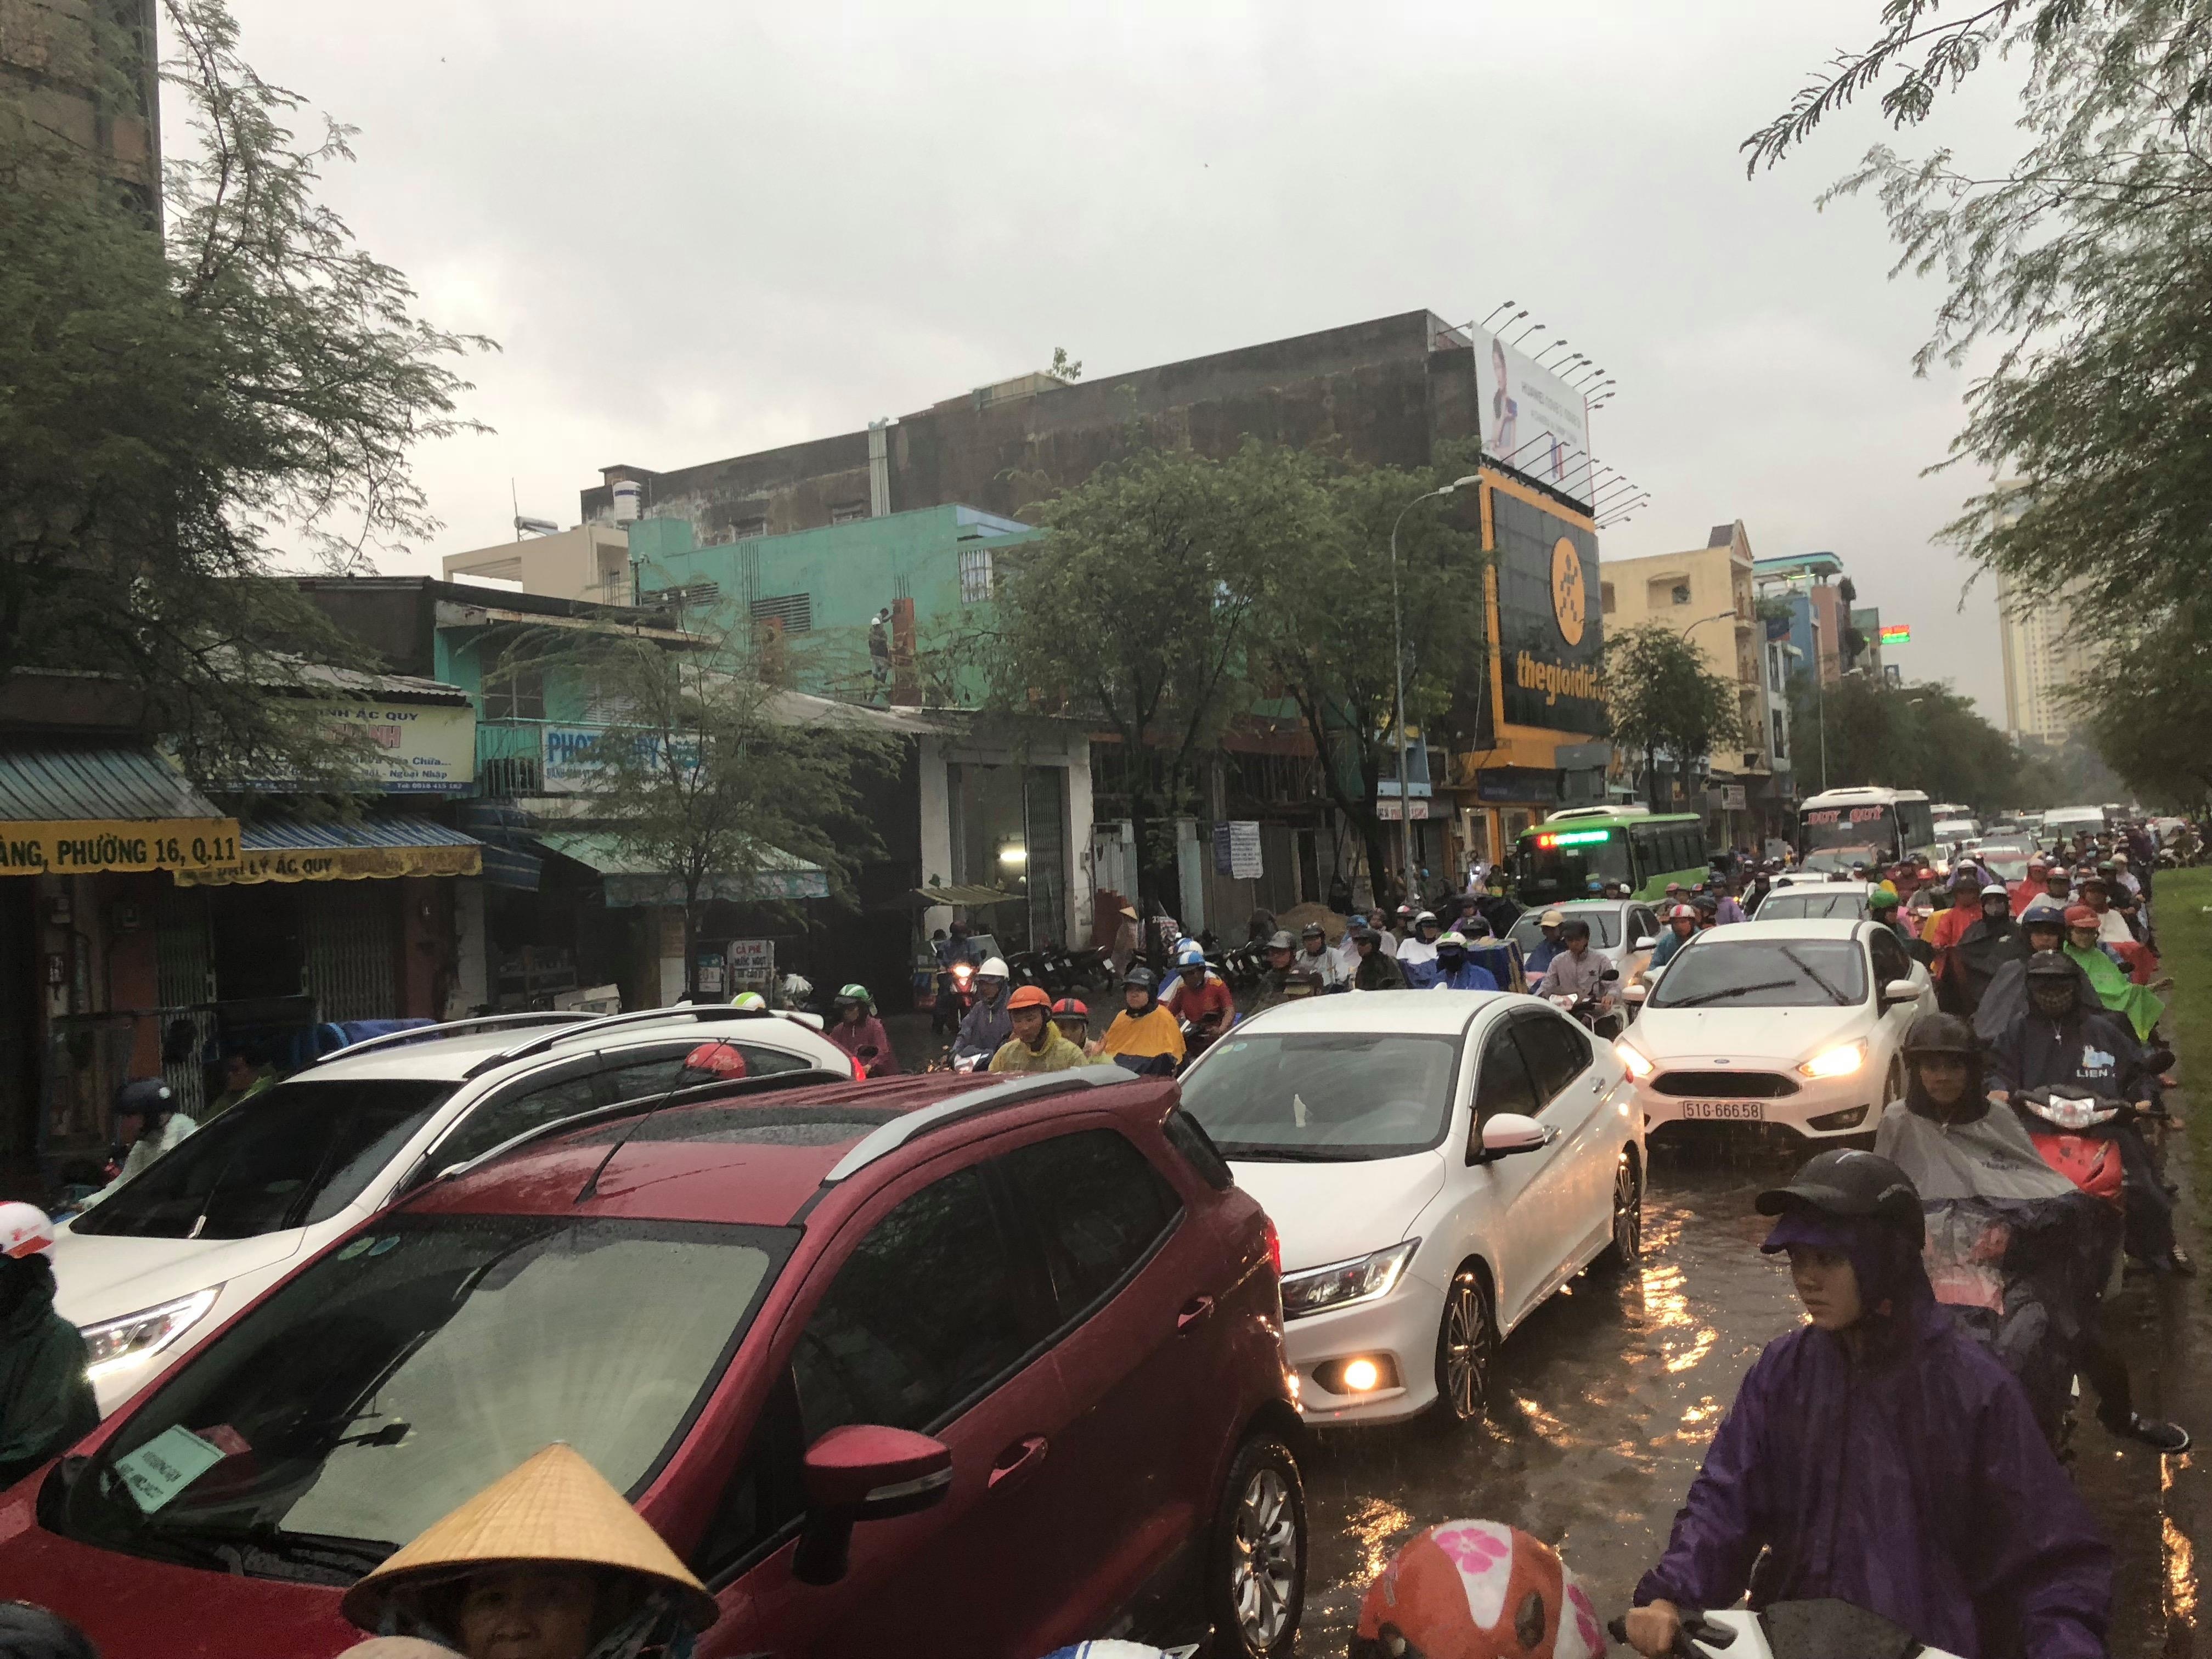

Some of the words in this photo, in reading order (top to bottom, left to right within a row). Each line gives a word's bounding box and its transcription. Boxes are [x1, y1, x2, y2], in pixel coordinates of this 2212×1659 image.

[386, 711, 418, 721] QUY
[1809, 810, 1841, 825] DUY
[57, 833, 147, 866] PHƯỜNG
[155, 838, 186, 867] 16,
[192, 837, 236, 865] Q.11
[302, 857, 333, 875] QUY
